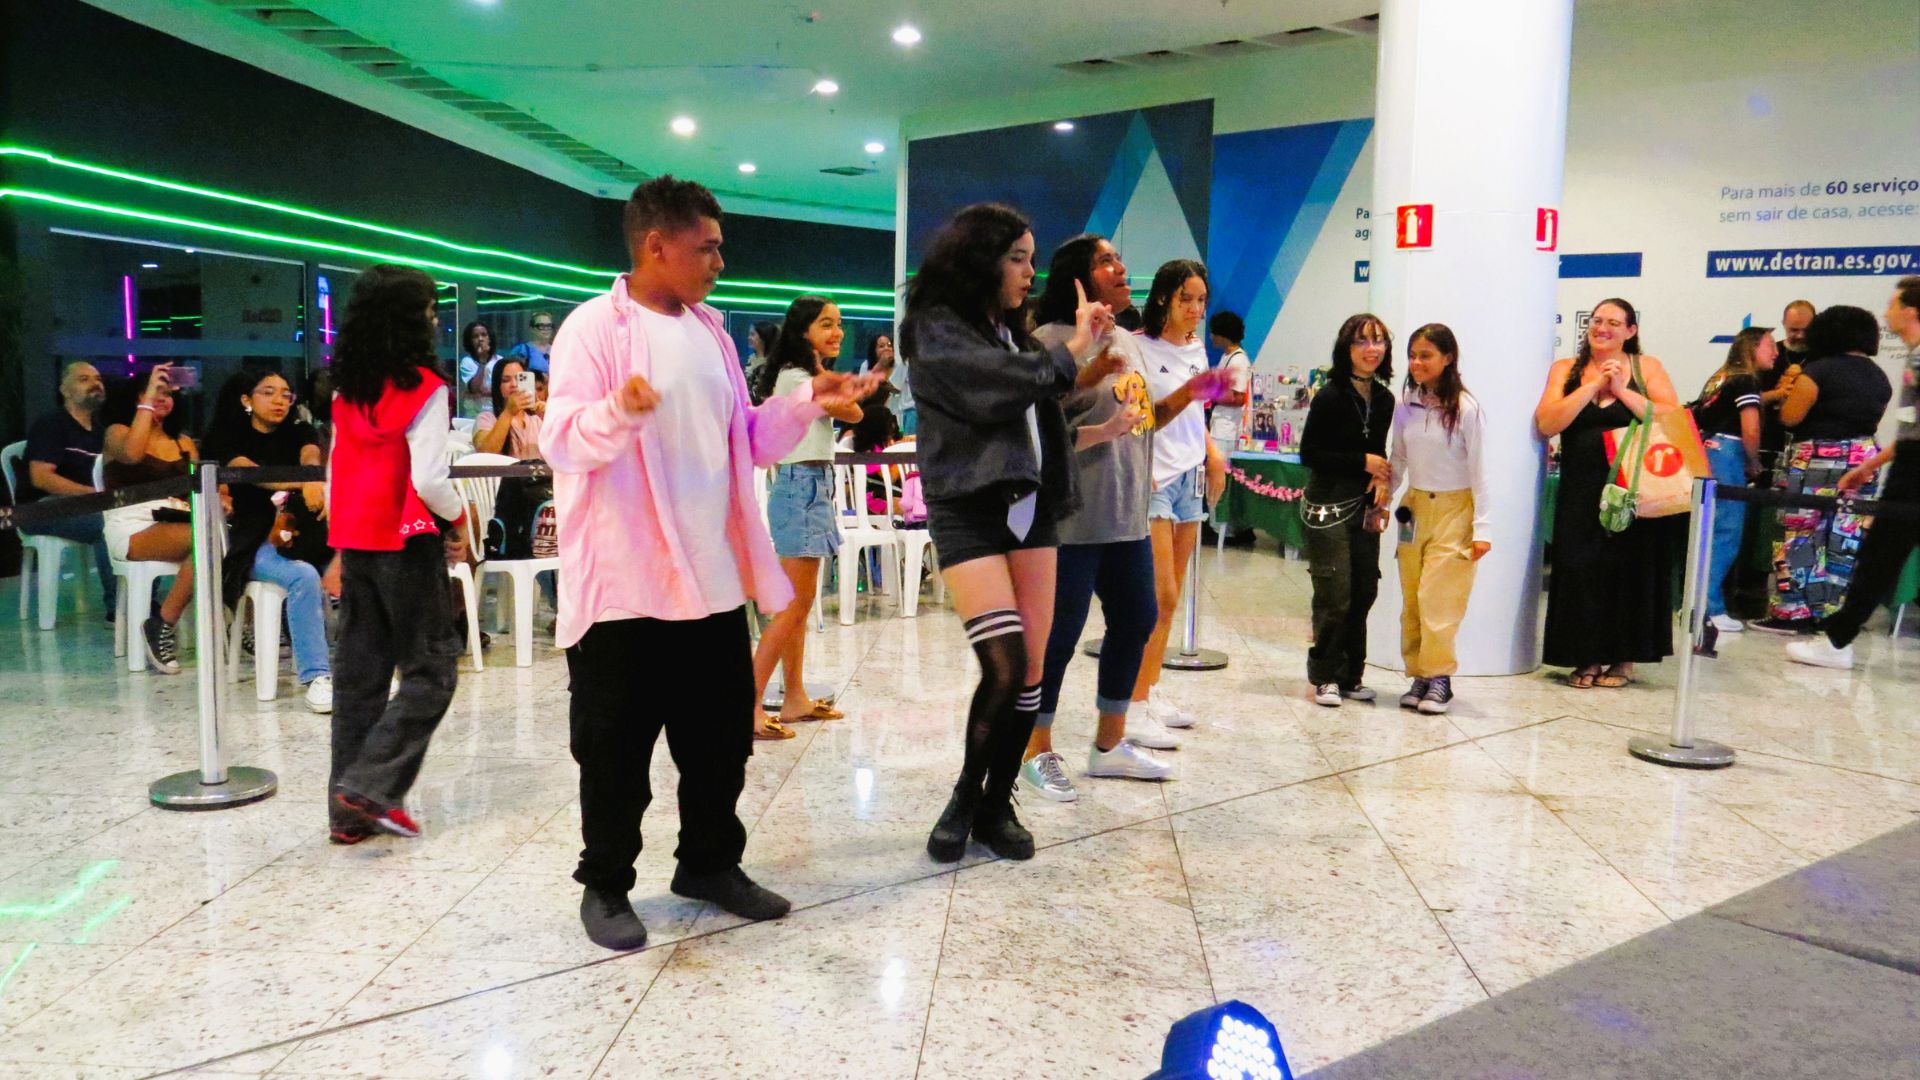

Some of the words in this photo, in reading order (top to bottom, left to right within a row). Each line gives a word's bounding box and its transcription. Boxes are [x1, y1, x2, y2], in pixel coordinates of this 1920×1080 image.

[1720, 186, 1754, 200] Para
[1758, 183, 1796, 198] mais
[1799, 182, 1822, 197] de
[1825, 180, 1849, 195] 60
[1719, 210, 1751, 223] sem
[1755, 206, 1784, 222] sair
[1787, 205, 1809, 221] de
[1812, 206, 1853, 221] casa,
[1715, 251, 1920, 274] www.detran.es.gov.
